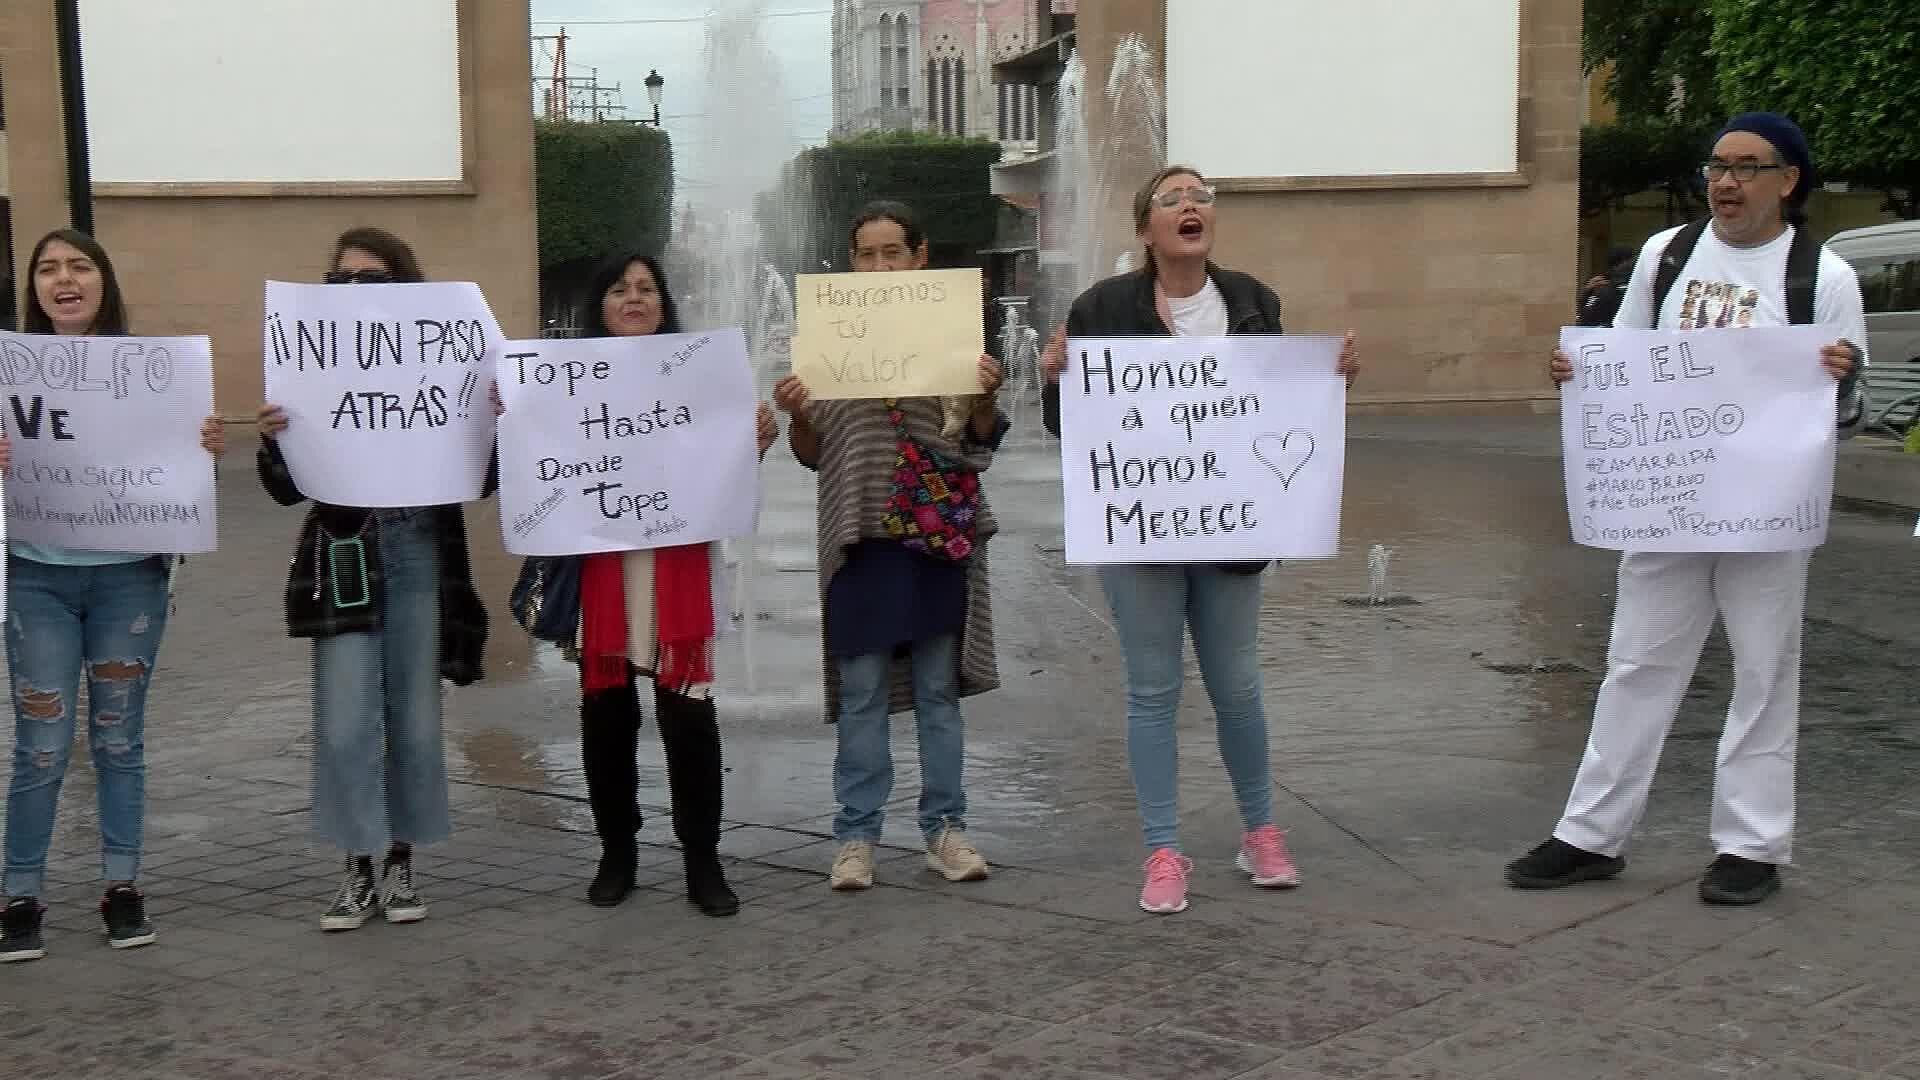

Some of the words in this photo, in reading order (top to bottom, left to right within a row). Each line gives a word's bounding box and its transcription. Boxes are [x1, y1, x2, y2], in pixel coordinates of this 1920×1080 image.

[816, 281, 946, 308] Honramos
[356, 319, 403, 371] UN
[415, 318, 486, 364] PASO
[1649, 341, 1714, 383] EL
[0, 339, 174, 400] DOLFO
[503, 352, 611, 397] Tope
[820, 348, 919, 384] Valor
[578, 400, 692, 440] Hasta
[1121, 407, 1144, 431] a
[1170, 392, 1260, 443] quien
[79, 464, 167, 500] sigue
[536, 454, 624, 482] Donde
